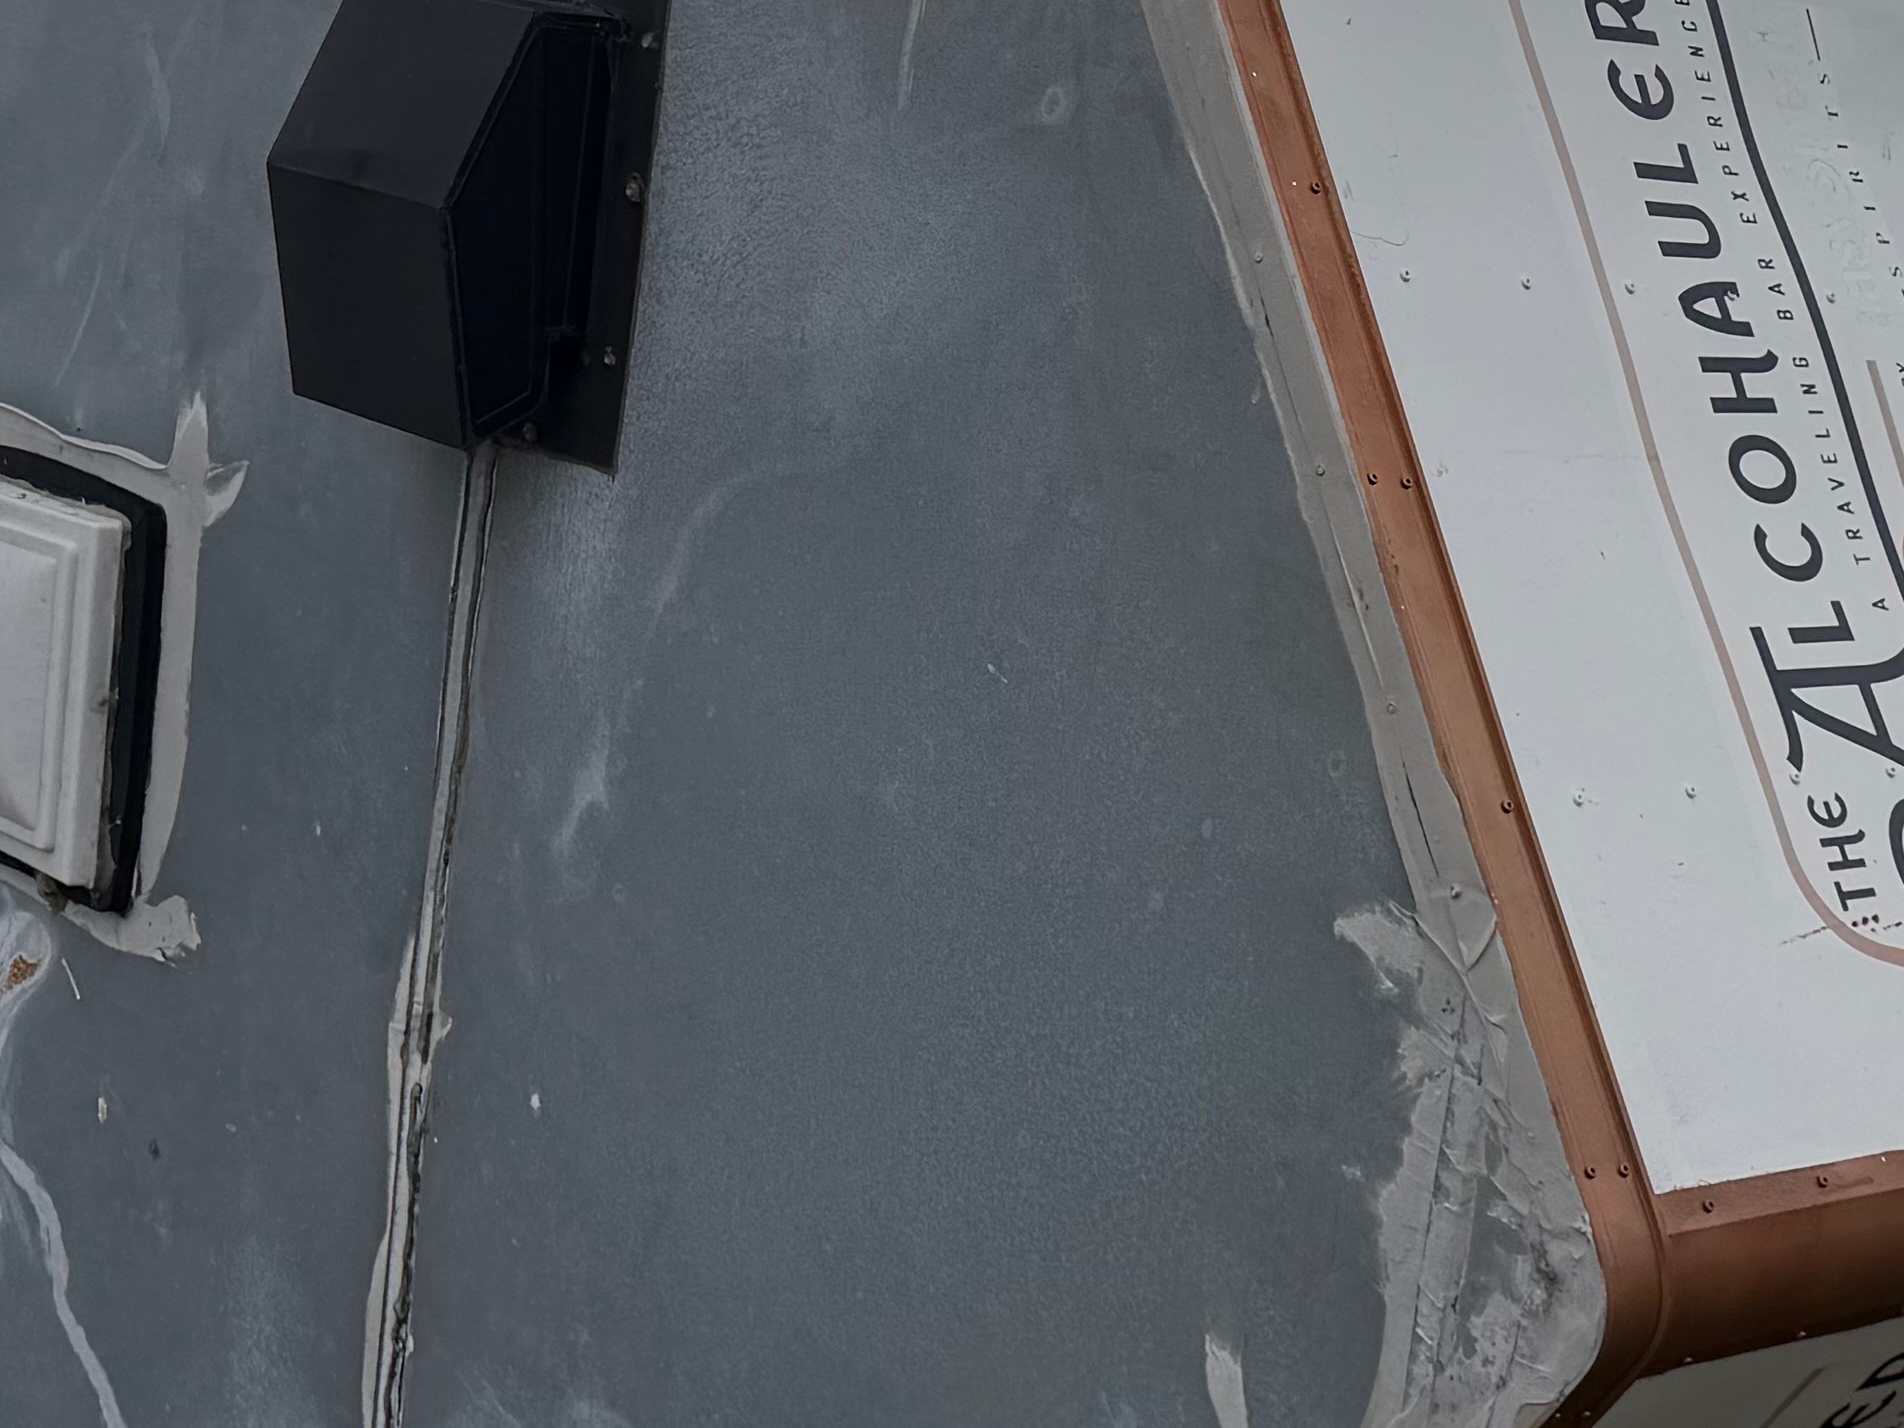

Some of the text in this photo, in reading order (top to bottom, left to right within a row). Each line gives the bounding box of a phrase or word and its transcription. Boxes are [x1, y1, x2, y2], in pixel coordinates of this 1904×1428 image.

[1817, 72, 1904, 281] SPIRITS
[1757, 257, 1795, 323] BAR
[1792, 355, 1873, 566] TRAVELING
[1872, 595, 1891, 613] A
[1806, 790, 1879, 913] THE
